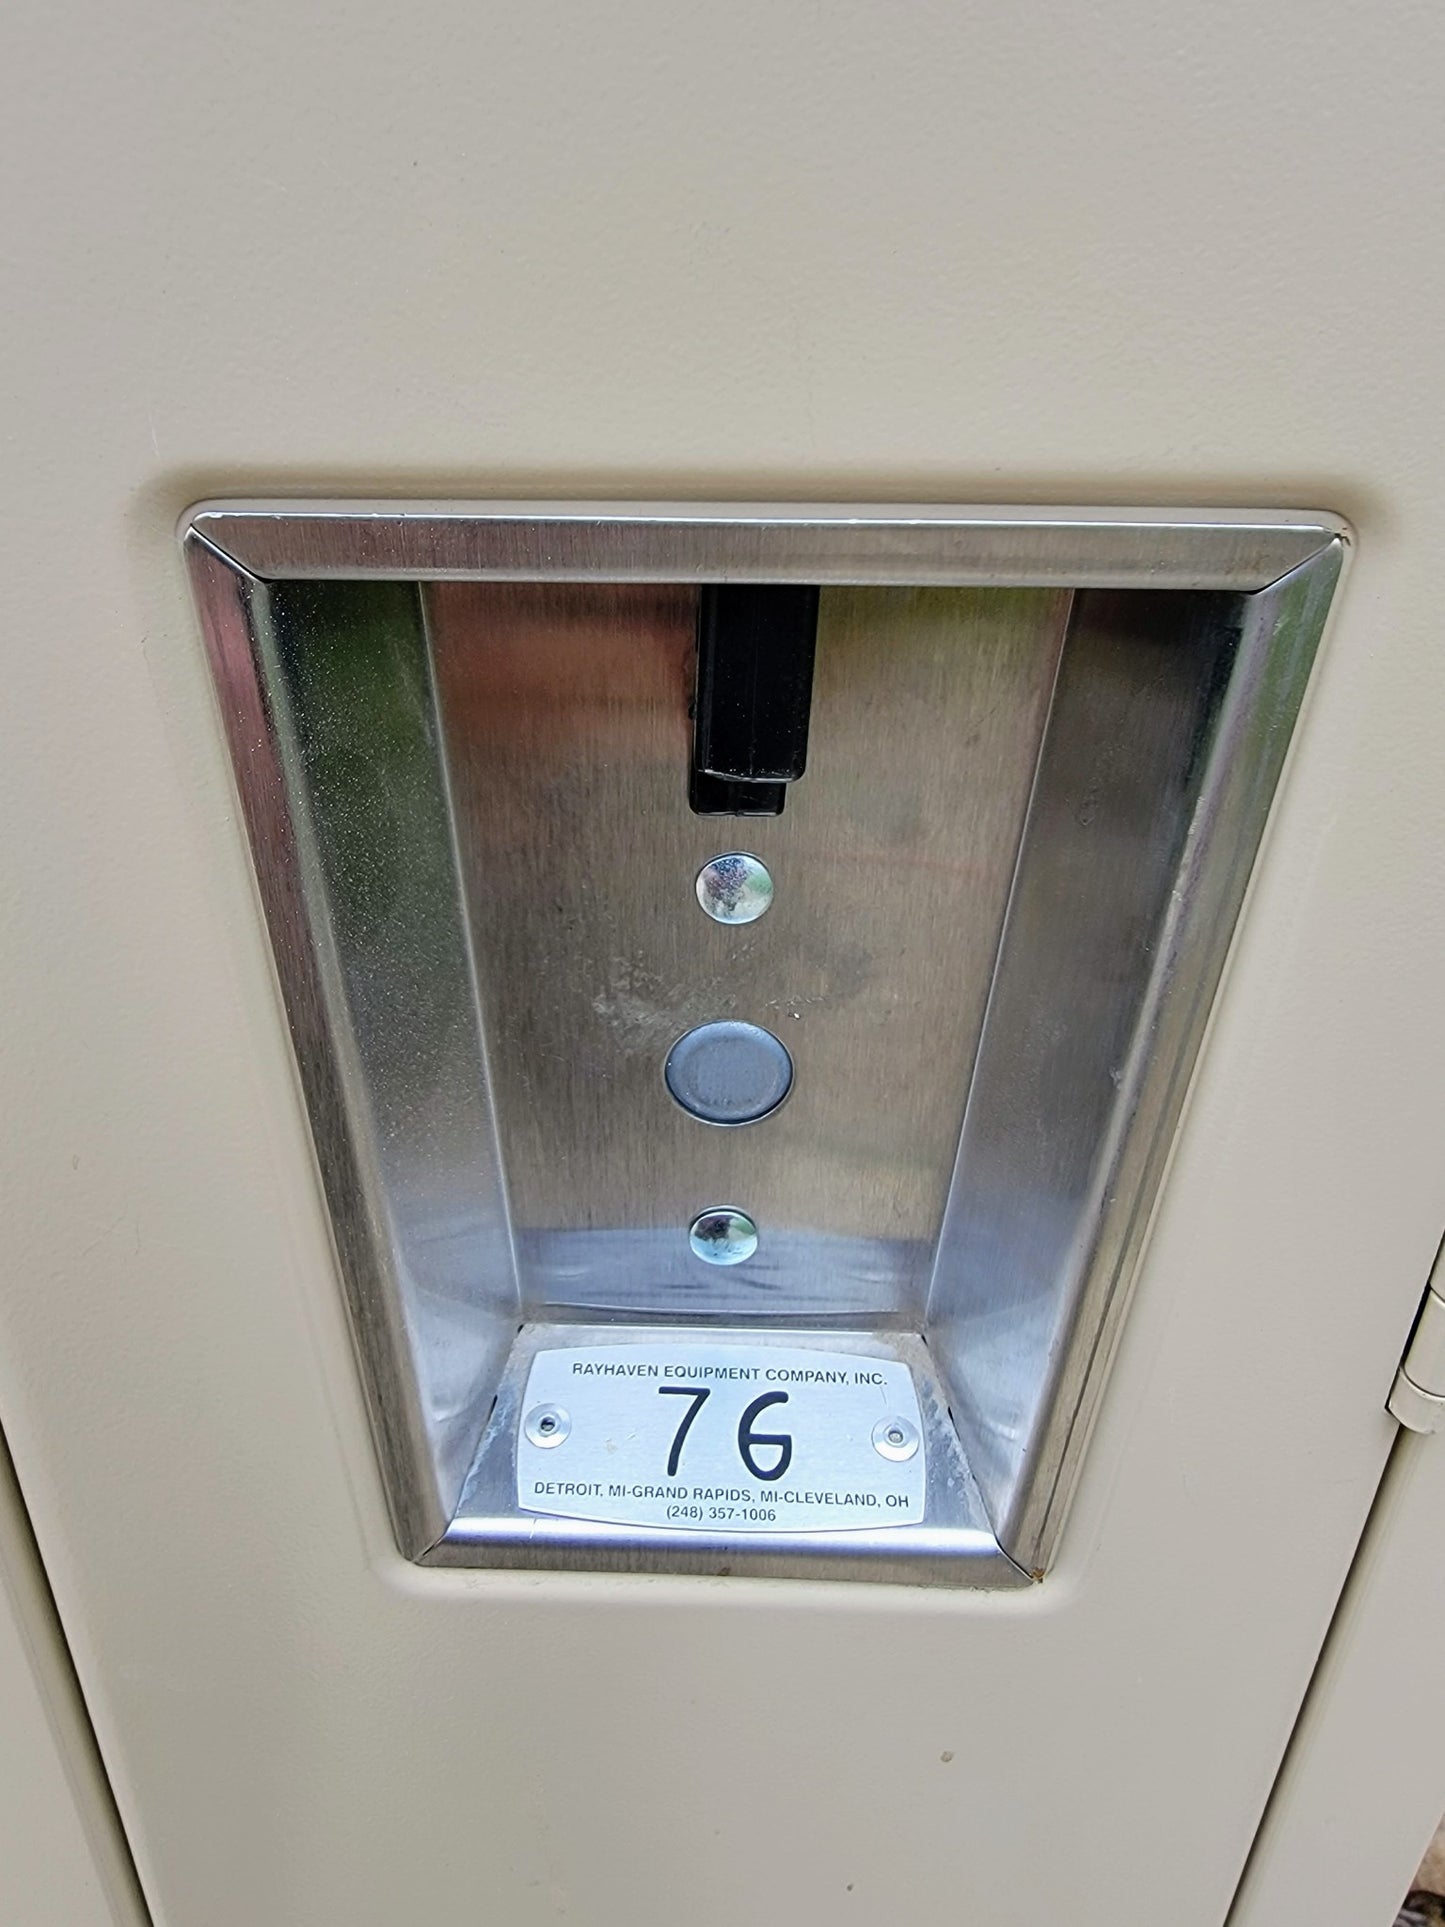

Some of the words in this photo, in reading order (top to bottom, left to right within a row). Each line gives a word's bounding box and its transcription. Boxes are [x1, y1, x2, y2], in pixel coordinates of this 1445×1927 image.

[573, 1362, 658, 1377] RAYHAVEN
[664, 1365, 761, 1381] EQUIPMENT
[765, 1368, 850, 1386] COMPANY,
[855, 1372, 888, 1386] INC.
[608, 1484, 689, 1500] MI-GRAND
[693, 1487, 755, 1503] RAPIDS,
[760, 1490, 881, 1508] MI-CLEVELAND,
[886, 1494, 909, 1509] OH
[666, 1504, 704, 1522] (248)
[708, 1506, 777, 1523] 357-1006
